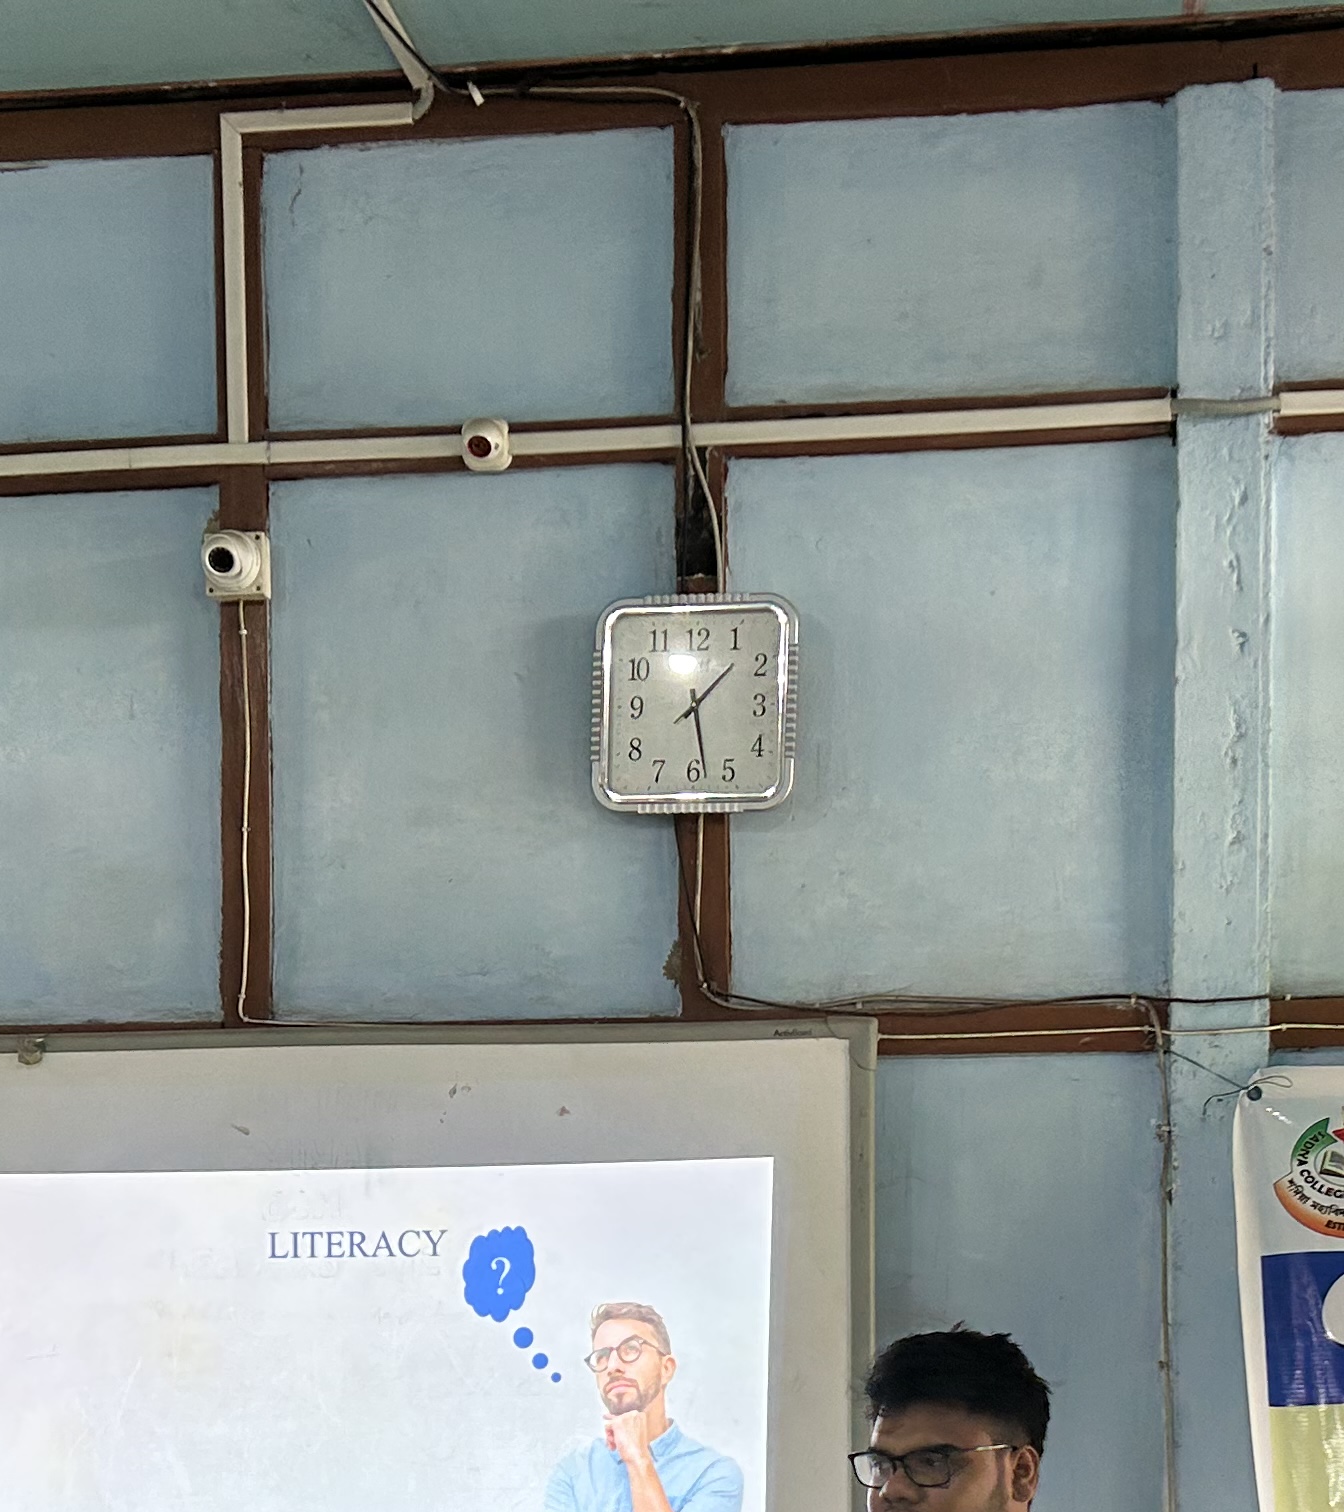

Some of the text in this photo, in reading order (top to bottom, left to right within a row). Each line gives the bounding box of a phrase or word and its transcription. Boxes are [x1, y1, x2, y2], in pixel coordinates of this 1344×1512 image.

[649, 629, 669, 652] 11
[685, 627, 710, 651] 12
[730, 627, 742, 650] 1
[628, 657, 650, 681] 10
[753, 653, 768, 677] 2
[630, 696, 645, 719] 9
[752, 693, 766, 717] 3
[628, 737, 643, 761] 8
[750, 734, 765, 757] 4
[652, 760, 666, 784] 7
[686, 759, 700, 782] 6
[721, 759, 736, 782] 5
[1296, 1131, 1326, 1167] SADIYA
[268, 1229, 448, 1260] LITERACY
[490, 1256, 511, 1295] ?
